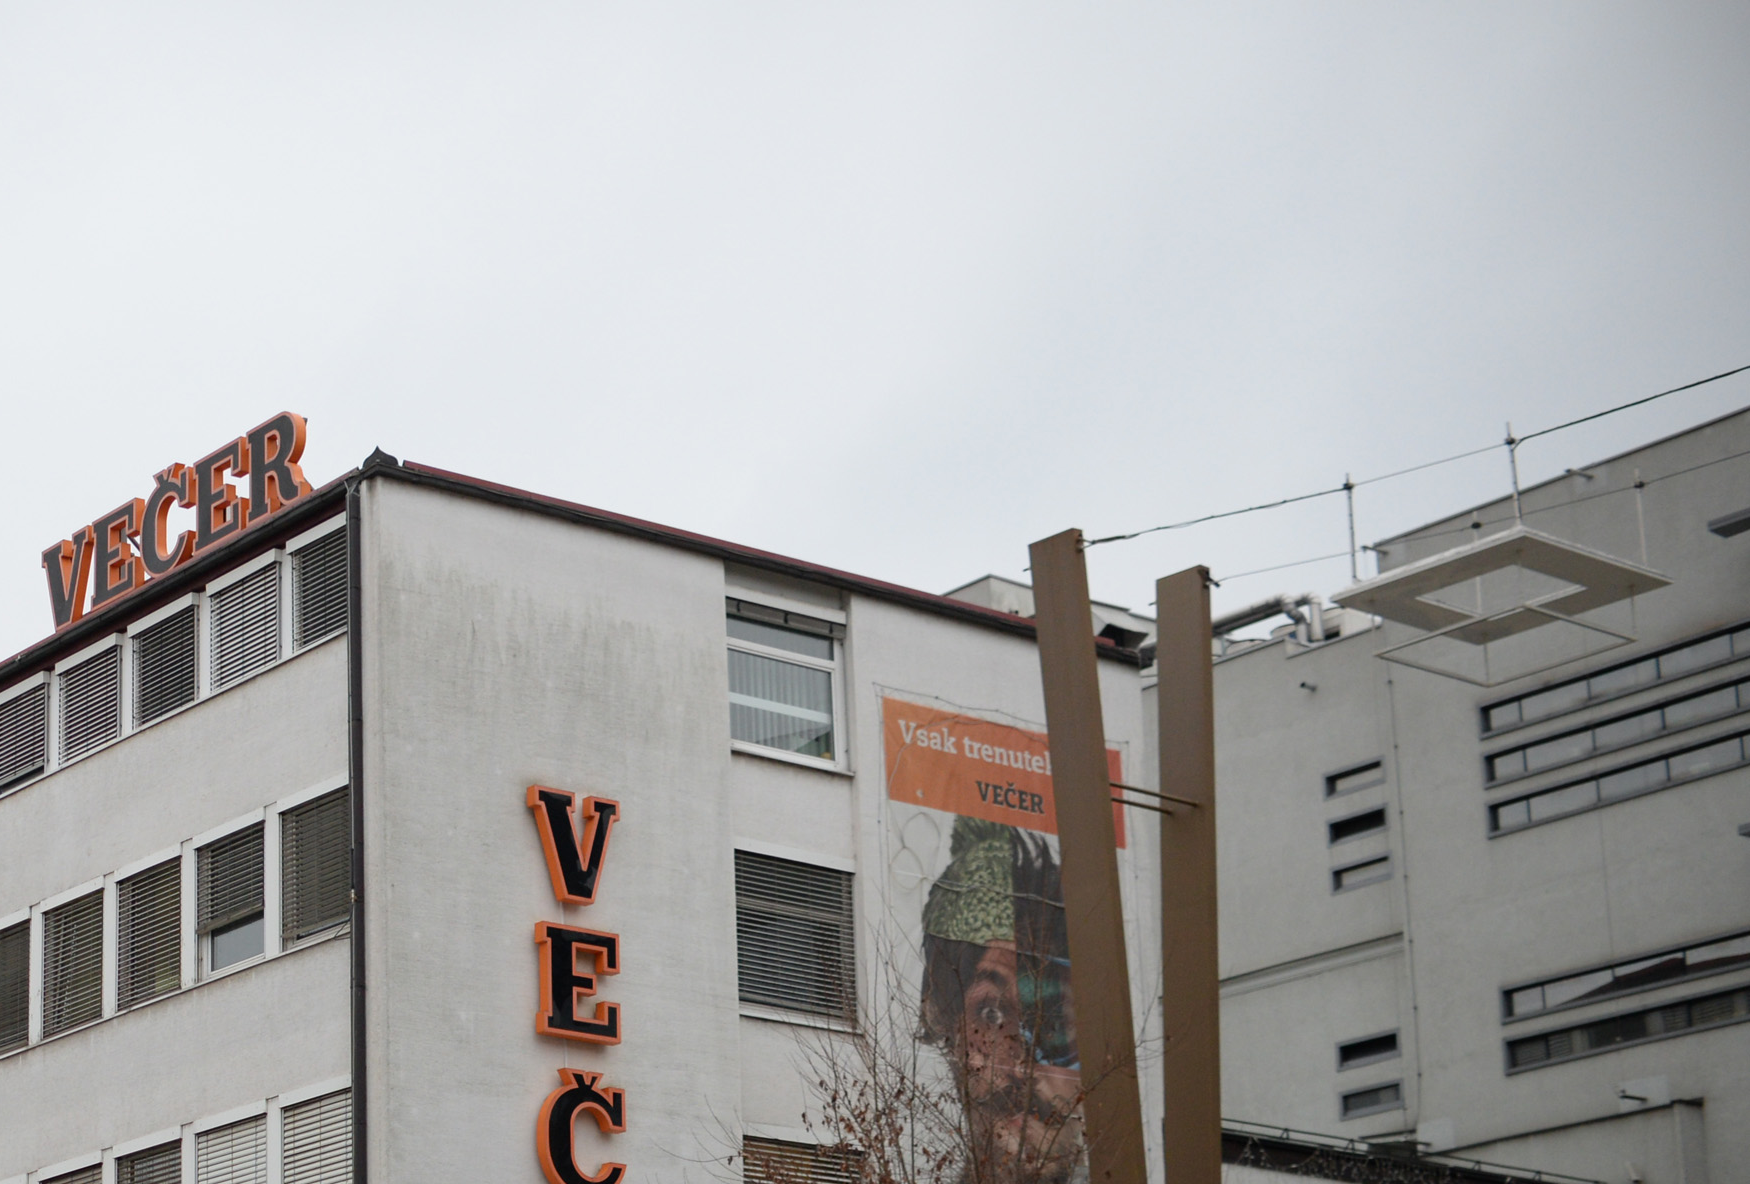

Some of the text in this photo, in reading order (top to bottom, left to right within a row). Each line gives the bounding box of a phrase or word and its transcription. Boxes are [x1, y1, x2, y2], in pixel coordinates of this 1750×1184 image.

[42, 411, 311, 633] VEČER
[898, 719, 958, 754] Vsak
[975, 780, 1046, 814] VEČER
